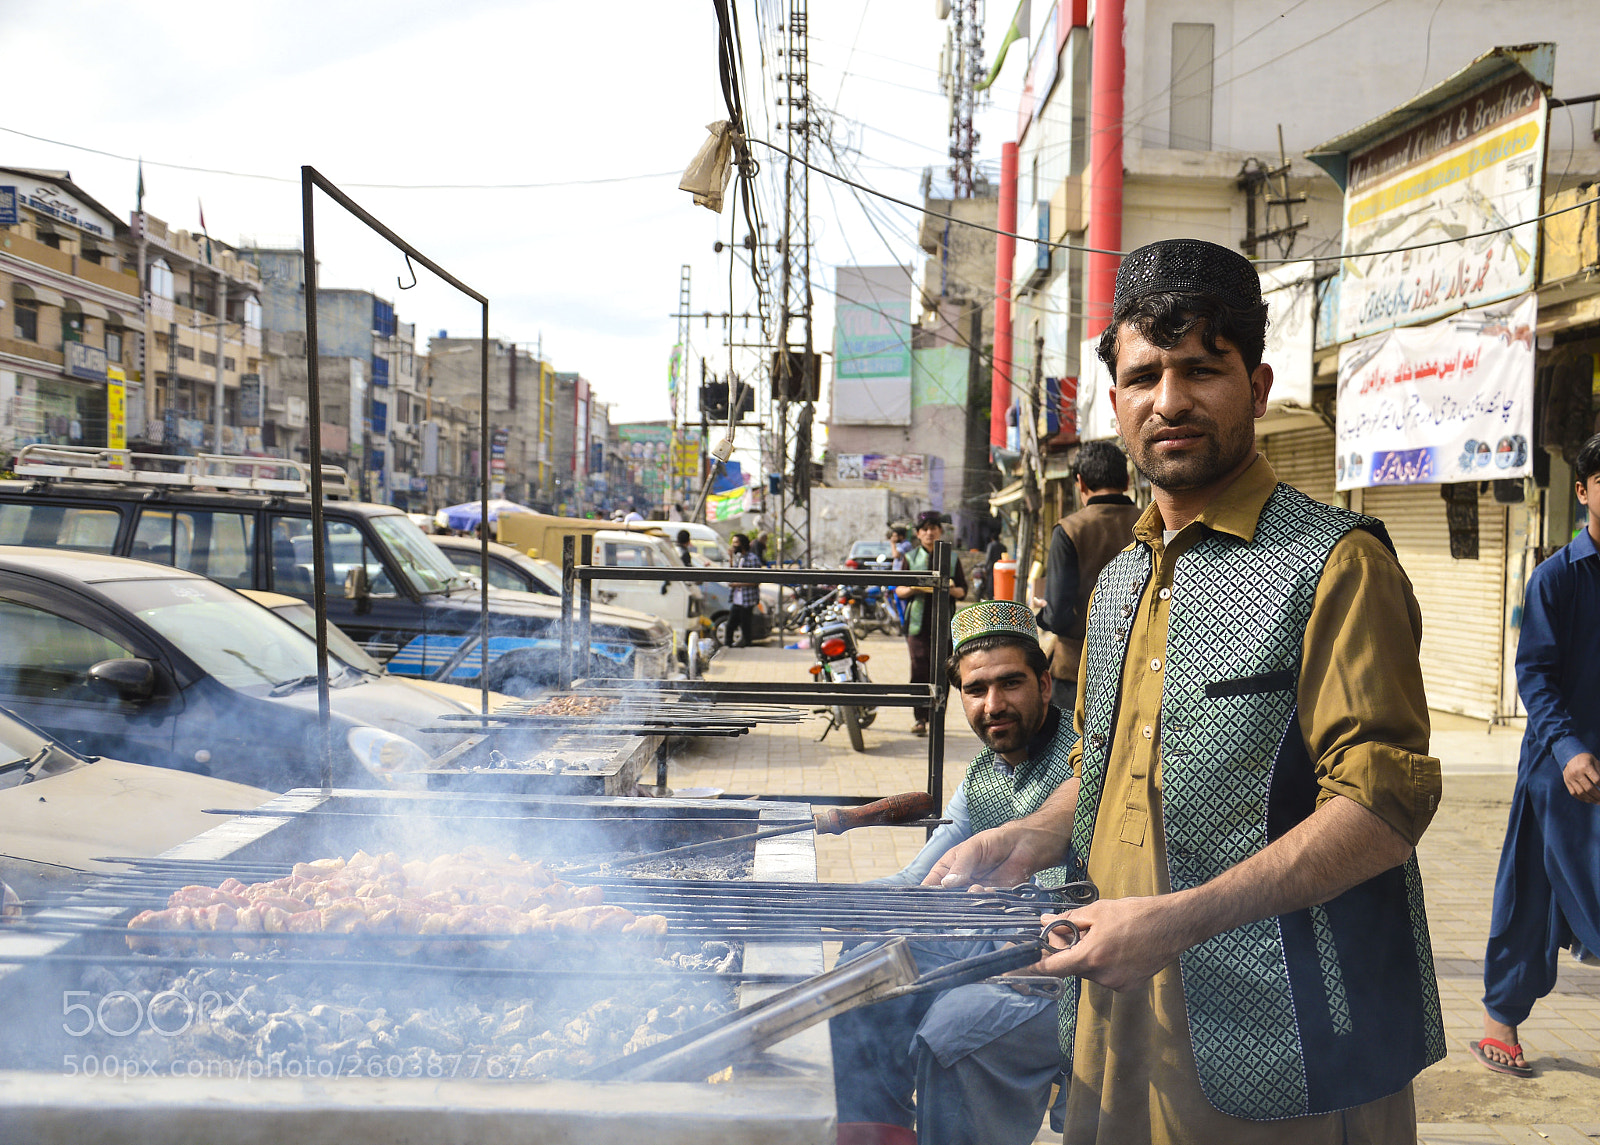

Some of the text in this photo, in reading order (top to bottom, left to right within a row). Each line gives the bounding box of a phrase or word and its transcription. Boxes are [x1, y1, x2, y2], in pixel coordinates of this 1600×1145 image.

[1456, 107, 1468, 141] &
[1472, 84, 1536, 133] Brothers
[1467, 132, 1531, 174] Dealers
